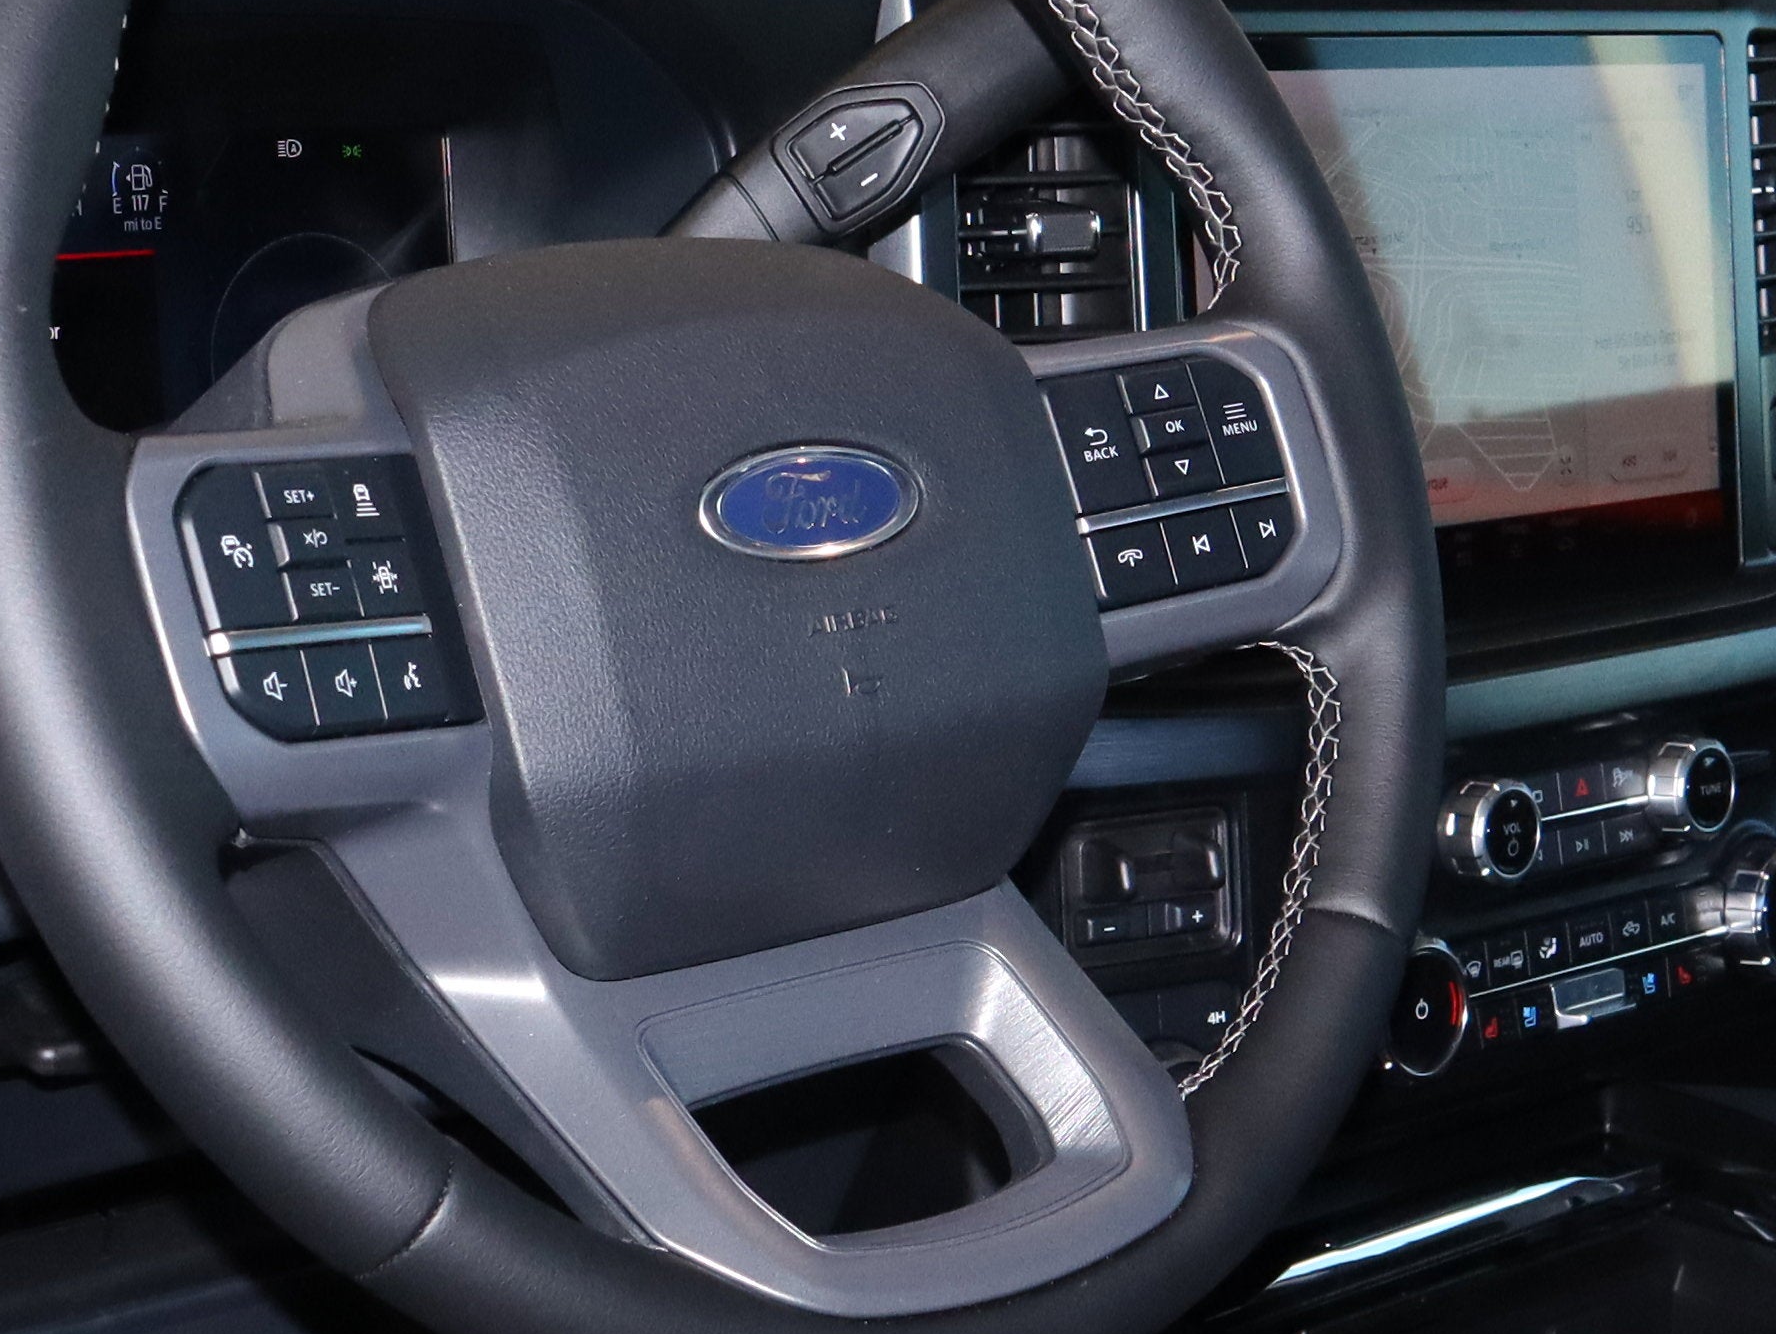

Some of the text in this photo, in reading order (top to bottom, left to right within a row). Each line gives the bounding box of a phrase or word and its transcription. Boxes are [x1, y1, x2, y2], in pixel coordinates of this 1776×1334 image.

[131, 194, 150, 212] 117
[123, 216, 162, 232] mi to E
[1165, 419, 1185, 434] OK
[1221, 419, 1258, 437] MENU
[1083, 444, 1119, 463] BACK
[763, 470, 866, 535] Ford
[1700, 782, 1723, 796] TUNE
[1503, 822, 1521, 835] VOL
[1660, 912, 1676, 926] A/C
[1578, 931, 1604, 948] AUTO
[1206, 1010, 1227, 1025] 4H
